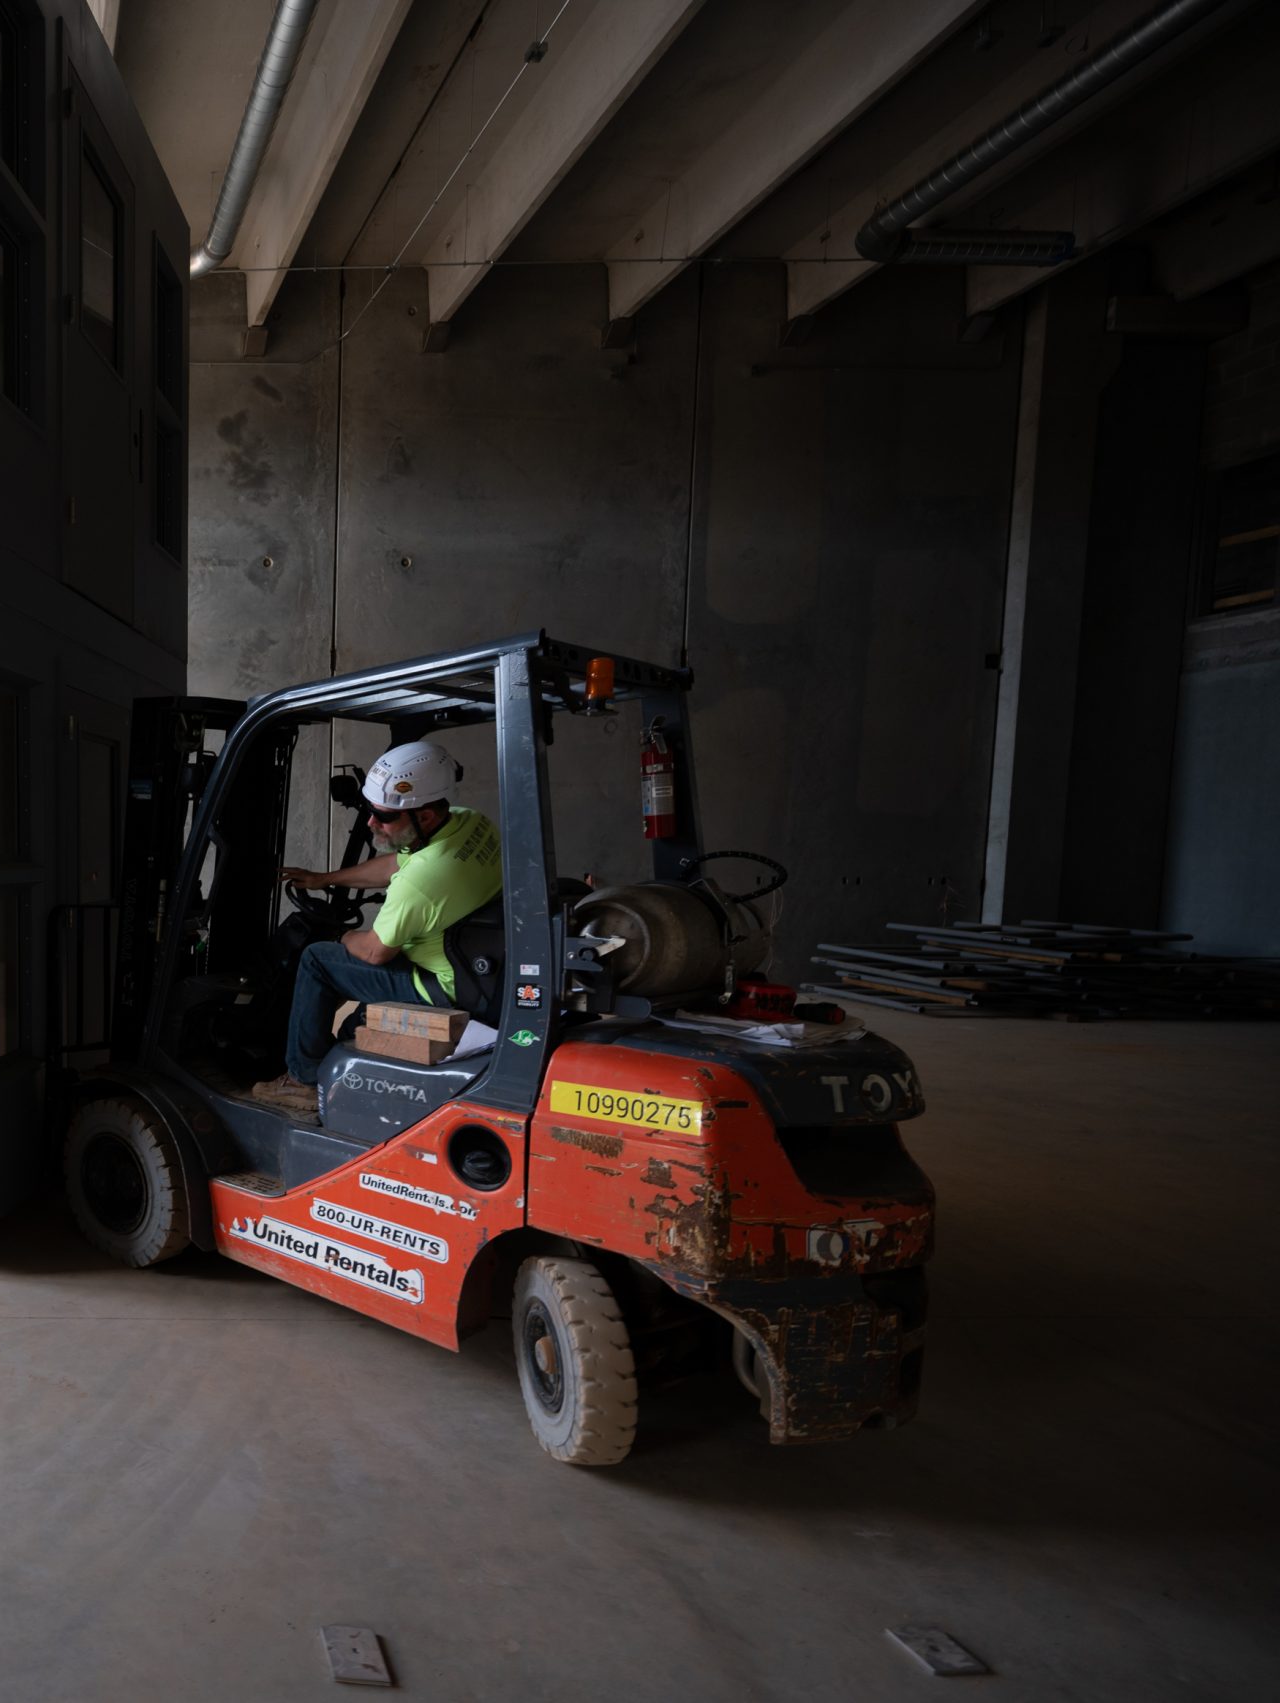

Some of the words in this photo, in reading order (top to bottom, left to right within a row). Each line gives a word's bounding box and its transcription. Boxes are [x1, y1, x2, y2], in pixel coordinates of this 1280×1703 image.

[516, 984, 542, 1001] SAS
[575, 1090, 692, 1129] 10990275
[317, 1205, 441, 1255] 800-UR-RENTS
[253, 1219, 320, 1260] United
[324, 1245, 409, 1292] Rentals
